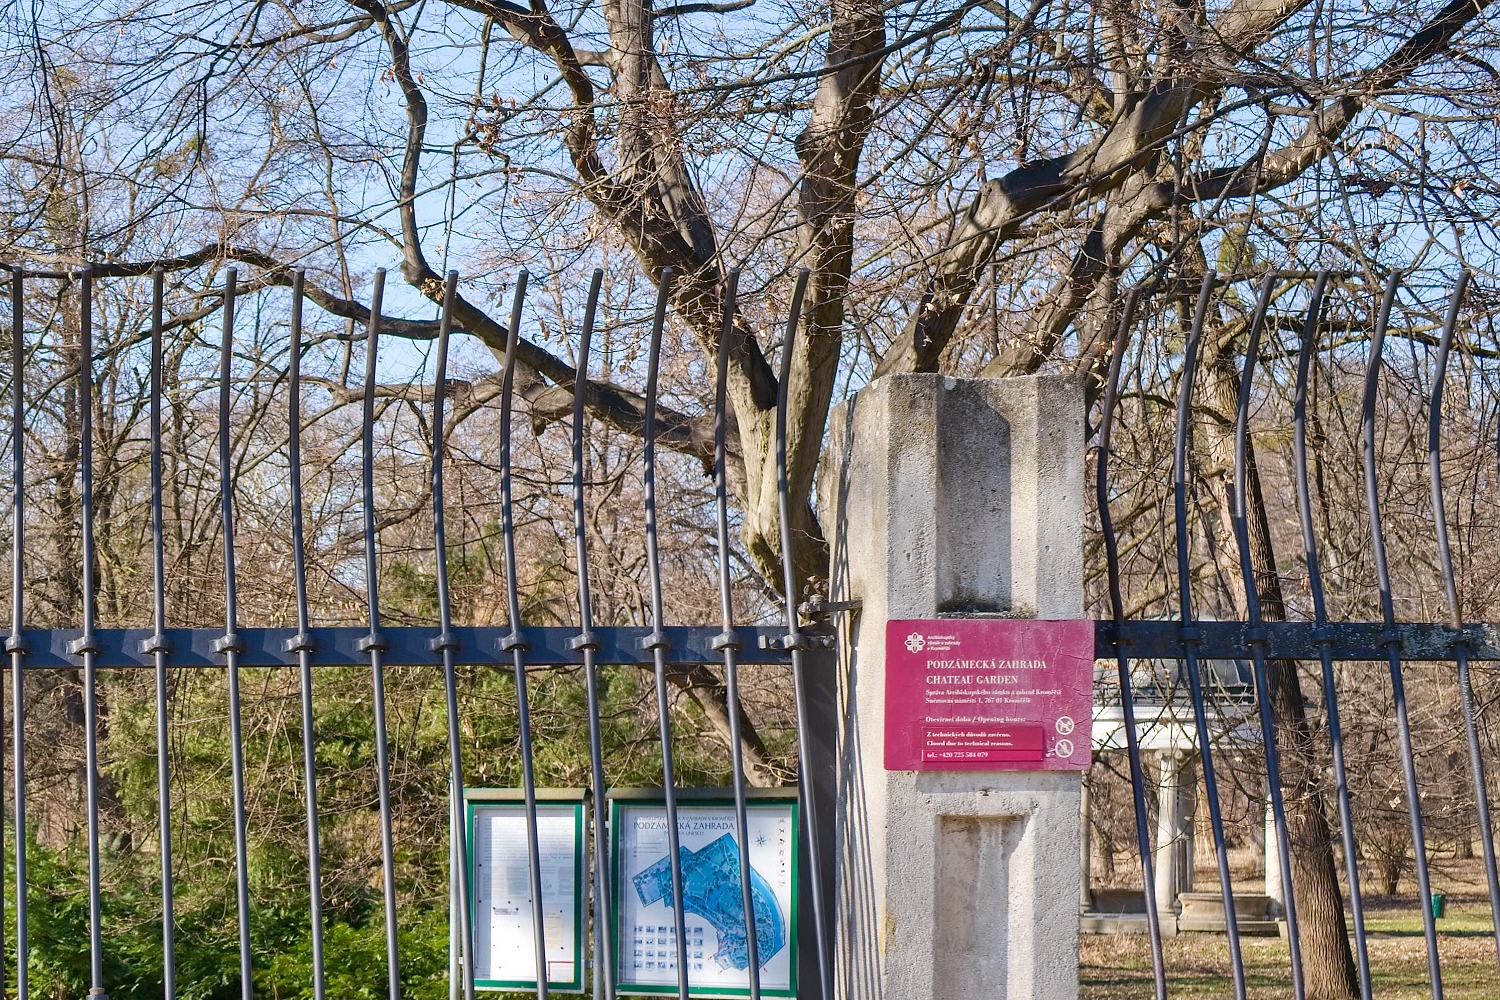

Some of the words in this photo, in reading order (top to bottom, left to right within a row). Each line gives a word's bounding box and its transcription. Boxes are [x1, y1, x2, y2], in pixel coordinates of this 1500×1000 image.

[927, 659, 996, 669] PODZÁMECKÁ
[999, 660, 1047, 669] ZAHRADA
[926, 675, 974, 684] CHATEAU
[976, 675, 1018, 684] GARDEN
[978, 716, 1005, 724] Opening
[693, 822, 735, 830] ZAHRADA
